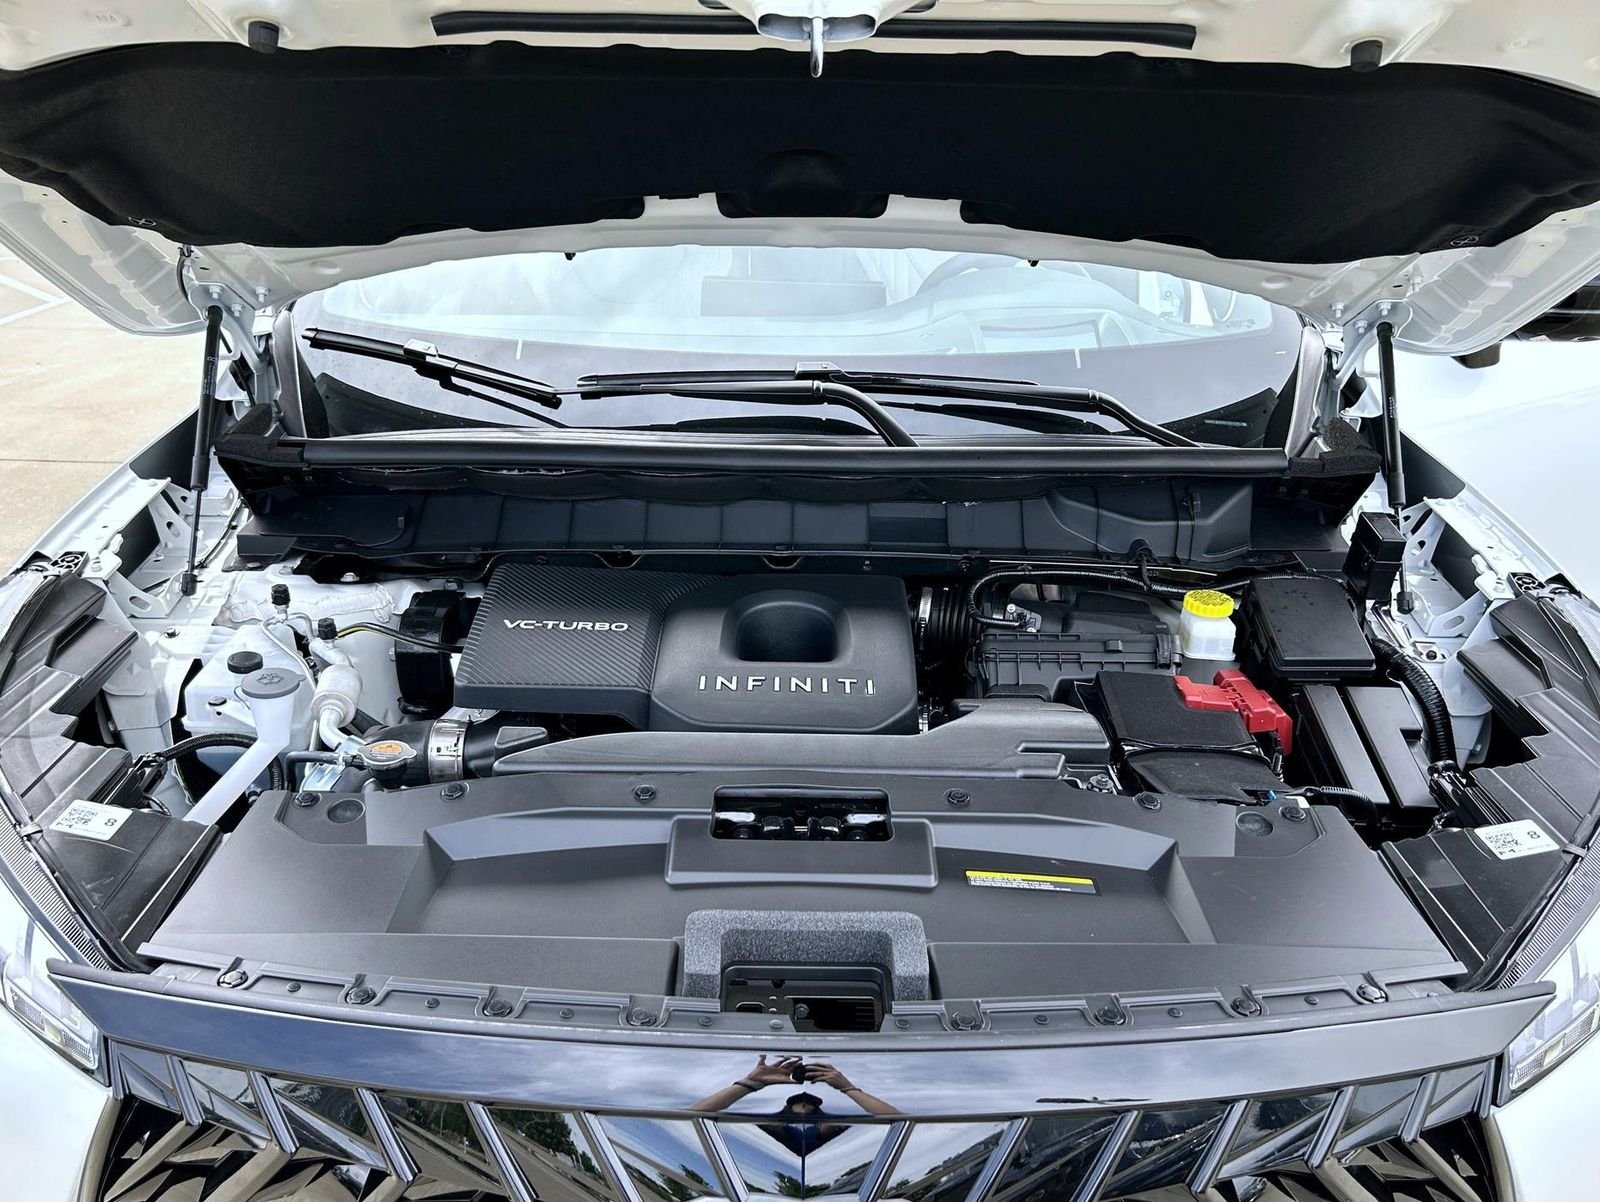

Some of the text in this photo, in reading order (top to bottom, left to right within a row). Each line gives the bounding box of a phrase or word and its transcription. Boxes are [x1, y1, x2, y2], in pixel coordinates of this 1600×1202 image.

[504, 619, 629, 631] VC-TURBO
[698, 676, 875, 695] INFINITI
[104, 818, 117, 827] 8
[1527, 831, 1540, 839] 8
